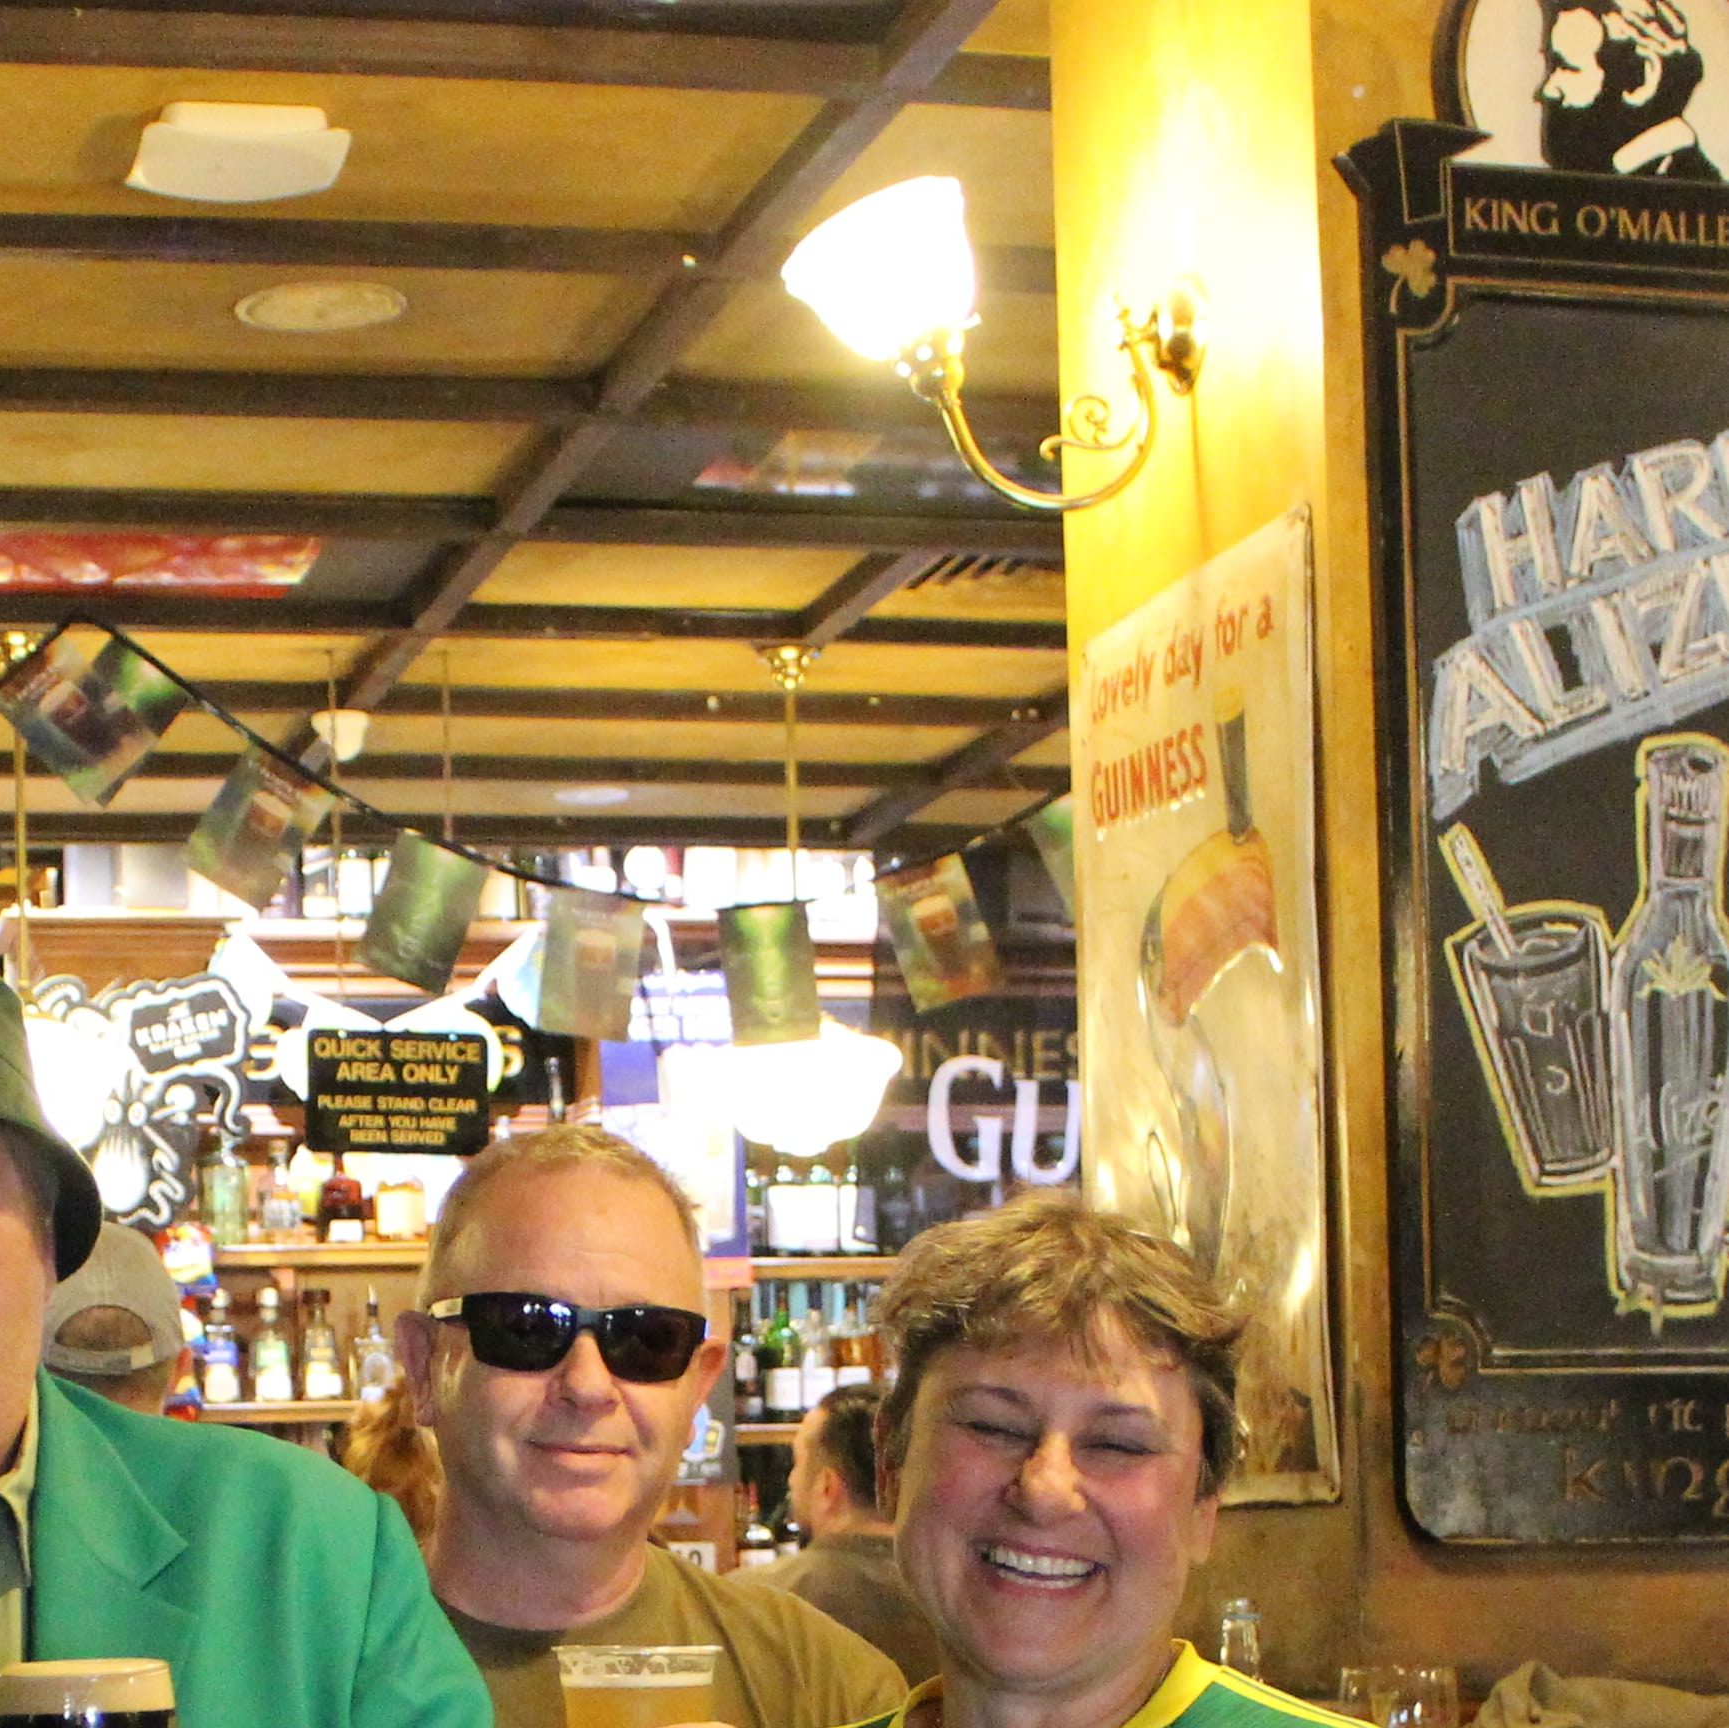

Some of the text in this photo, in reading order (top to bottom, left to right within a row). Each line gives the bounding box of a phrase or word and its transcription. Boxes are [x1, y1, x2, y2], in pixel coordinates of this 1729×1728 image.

[1464, 196, 1560, 236] KING
[1457, 430, 1729, 628] HAR
[1163, 622, 1205, 692] day
[1215, 600, 1249, 659] for
[1256, 595, 1274, 640] a
[1092, 723, 1207, 827] GUINNESS
[314, 1037, 383, 1060] QUICK
[390, 1039, 481, 1063] SERVICE
[336, 1061, 460, 1085] AREA ONLY
[317, 1094, 478, 1114] PLEASE STAND CLEAR
[339, 1114, 457, 1132] AFTER YOU HAVE
[350, 1129, 447, 1146] BEEN SERVED
